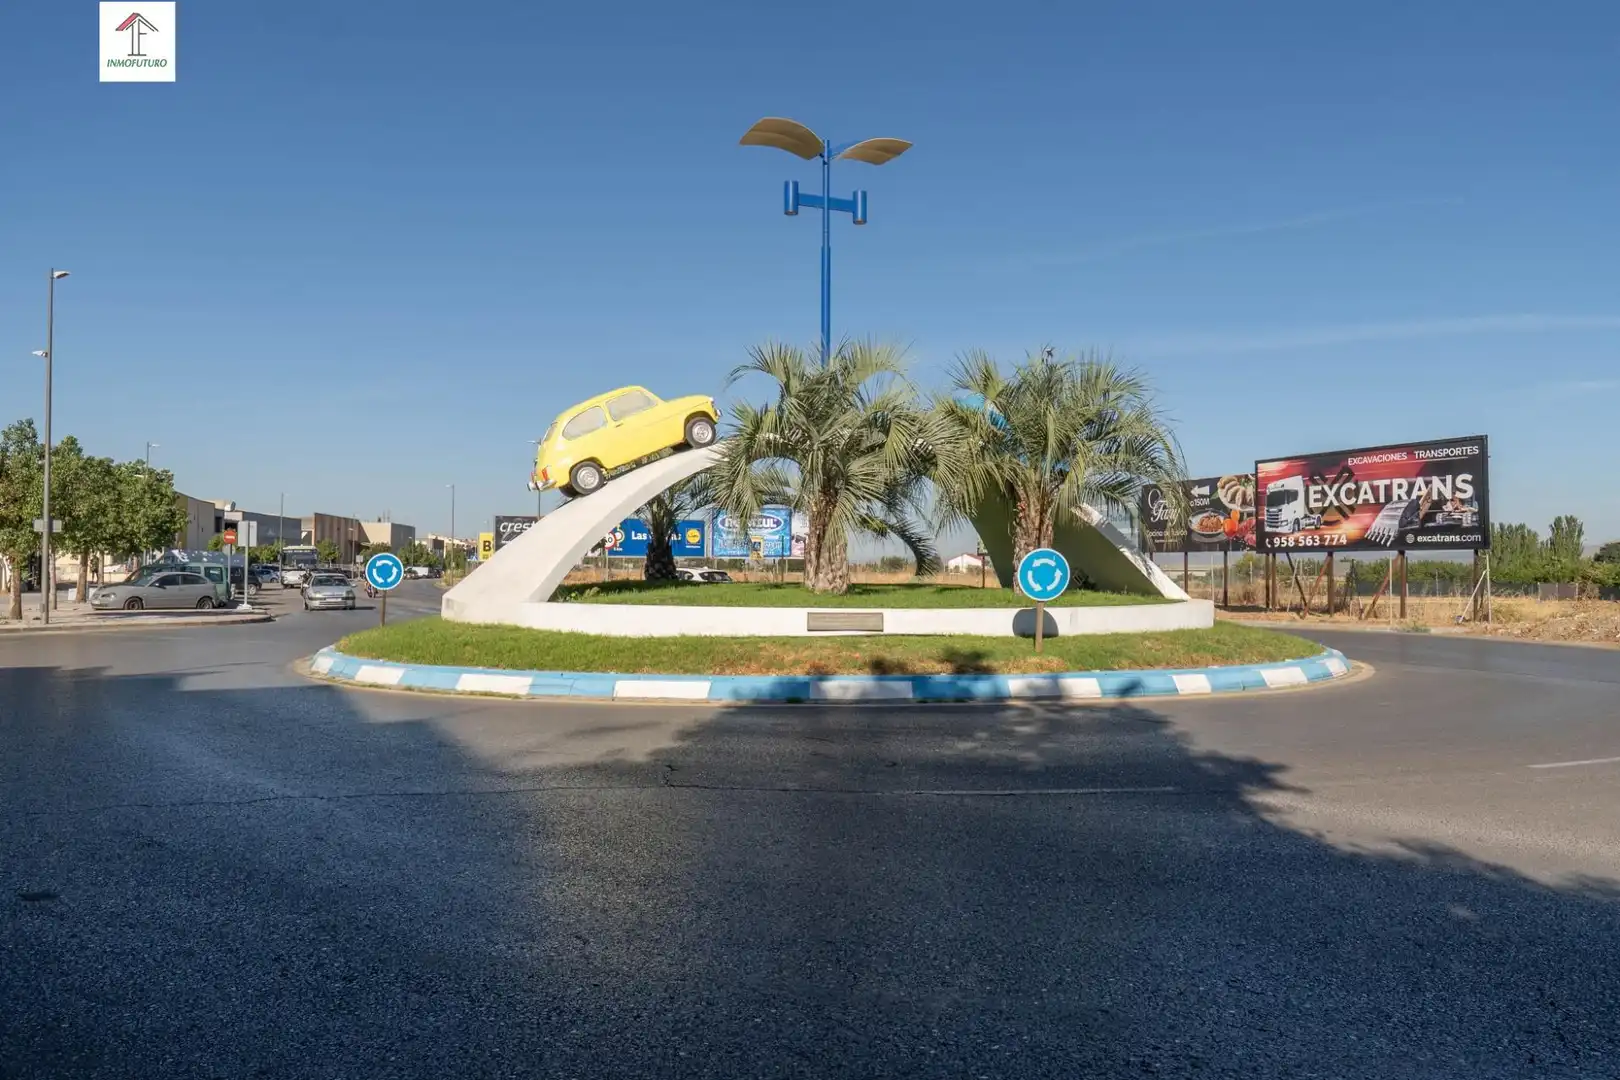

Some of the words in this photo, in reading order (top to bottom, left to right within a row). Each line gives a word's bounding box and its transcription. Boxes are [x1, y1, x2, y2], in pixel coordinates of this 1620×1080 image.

[1348, 452, 1408, 466] EXCAVACIONES
[1414, 446, 1479, 460] TRANSPORTES
[1308, 473, 1474, 508] EXCATRANS
[631, 530, 648, 540] Las
[1273, 535, 1294, 547] 958
[1298, 535, 1320, 546] 563
[1323, 533, 1347, 546] 774
[1417, 534, 1482, 543] excatrans.com
